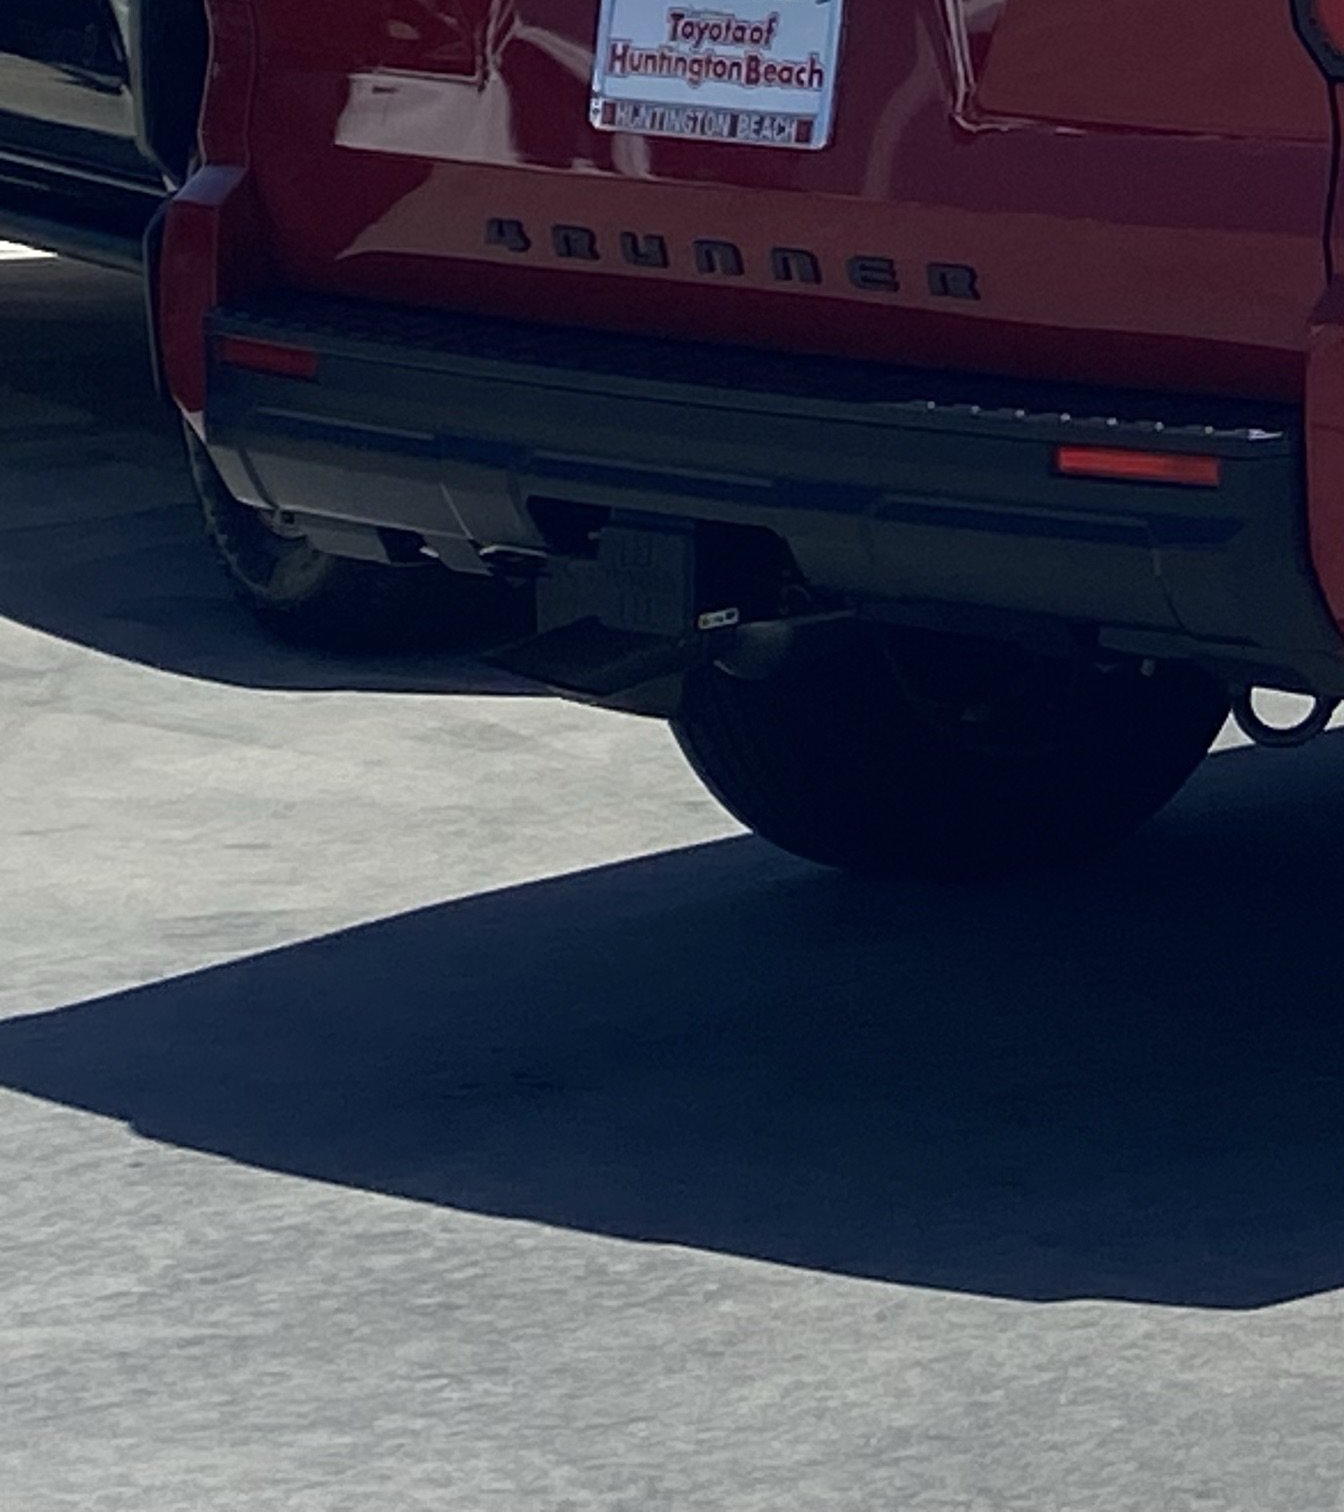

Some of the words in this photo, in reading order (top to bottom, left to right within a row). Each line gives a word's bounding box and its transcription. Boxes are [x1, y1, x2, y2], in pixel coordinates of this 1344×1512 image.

[669, 11, 746, 48] Toyota
[748, 13, 779, 47] of
[608, 43, 742, 85] Huntington
[744, 53, 825, 89] Beach
[615, 104, 731, 138] HUNTINGTON
[737, 114, 797, 143] BEACH
[485, 218, 981, 301] 4RUNNER
